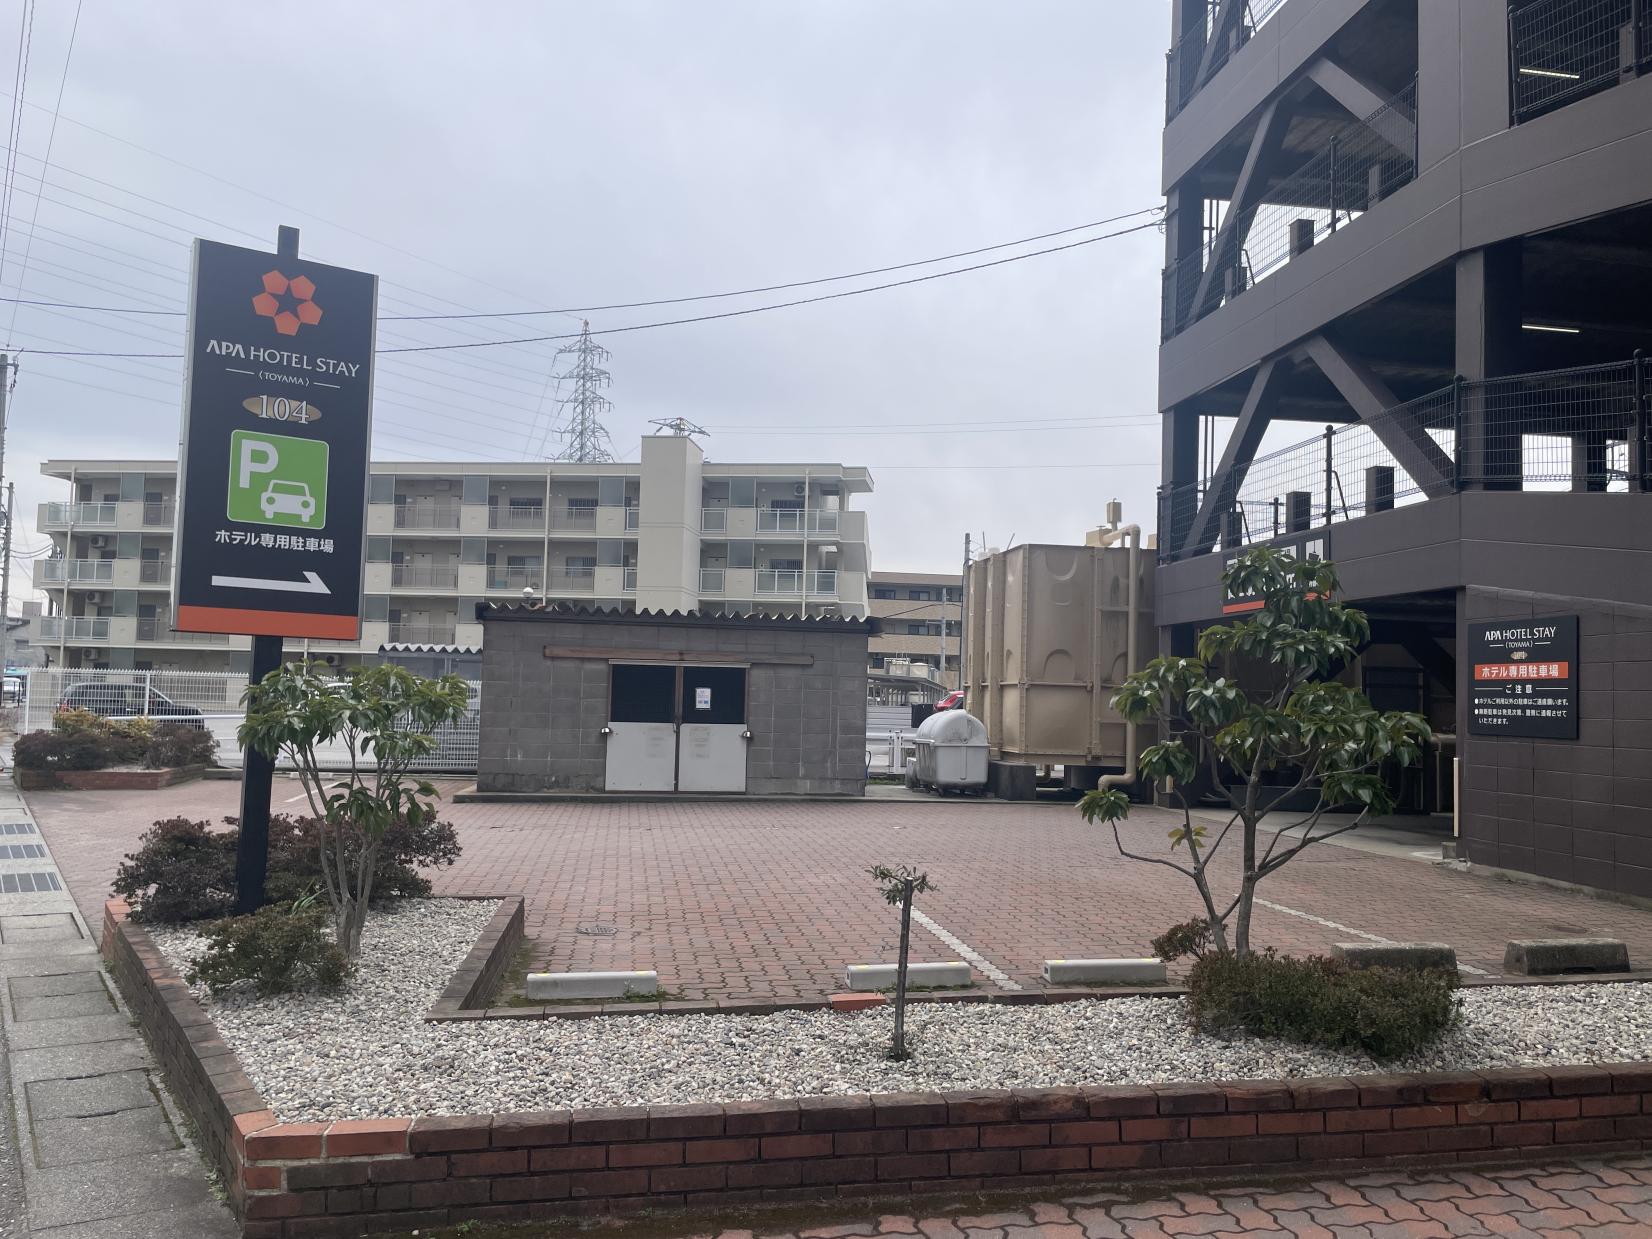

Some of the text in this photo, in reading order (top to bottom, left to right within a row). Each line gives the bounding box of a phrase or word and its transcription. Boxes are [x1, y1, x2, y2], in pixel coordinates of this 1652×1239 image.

[207, 340, 360, 377] APA HOTEL STAY
[258, 394, 309, 424] 104
[239, 439, 279, 489] P
[215, 530, 334, 553] ホテル専用駐車場
[1485, 626, 1556, 641] APA HOTEL STAY
[1482, 664, 1559, 678] ホテル専用駐車場
